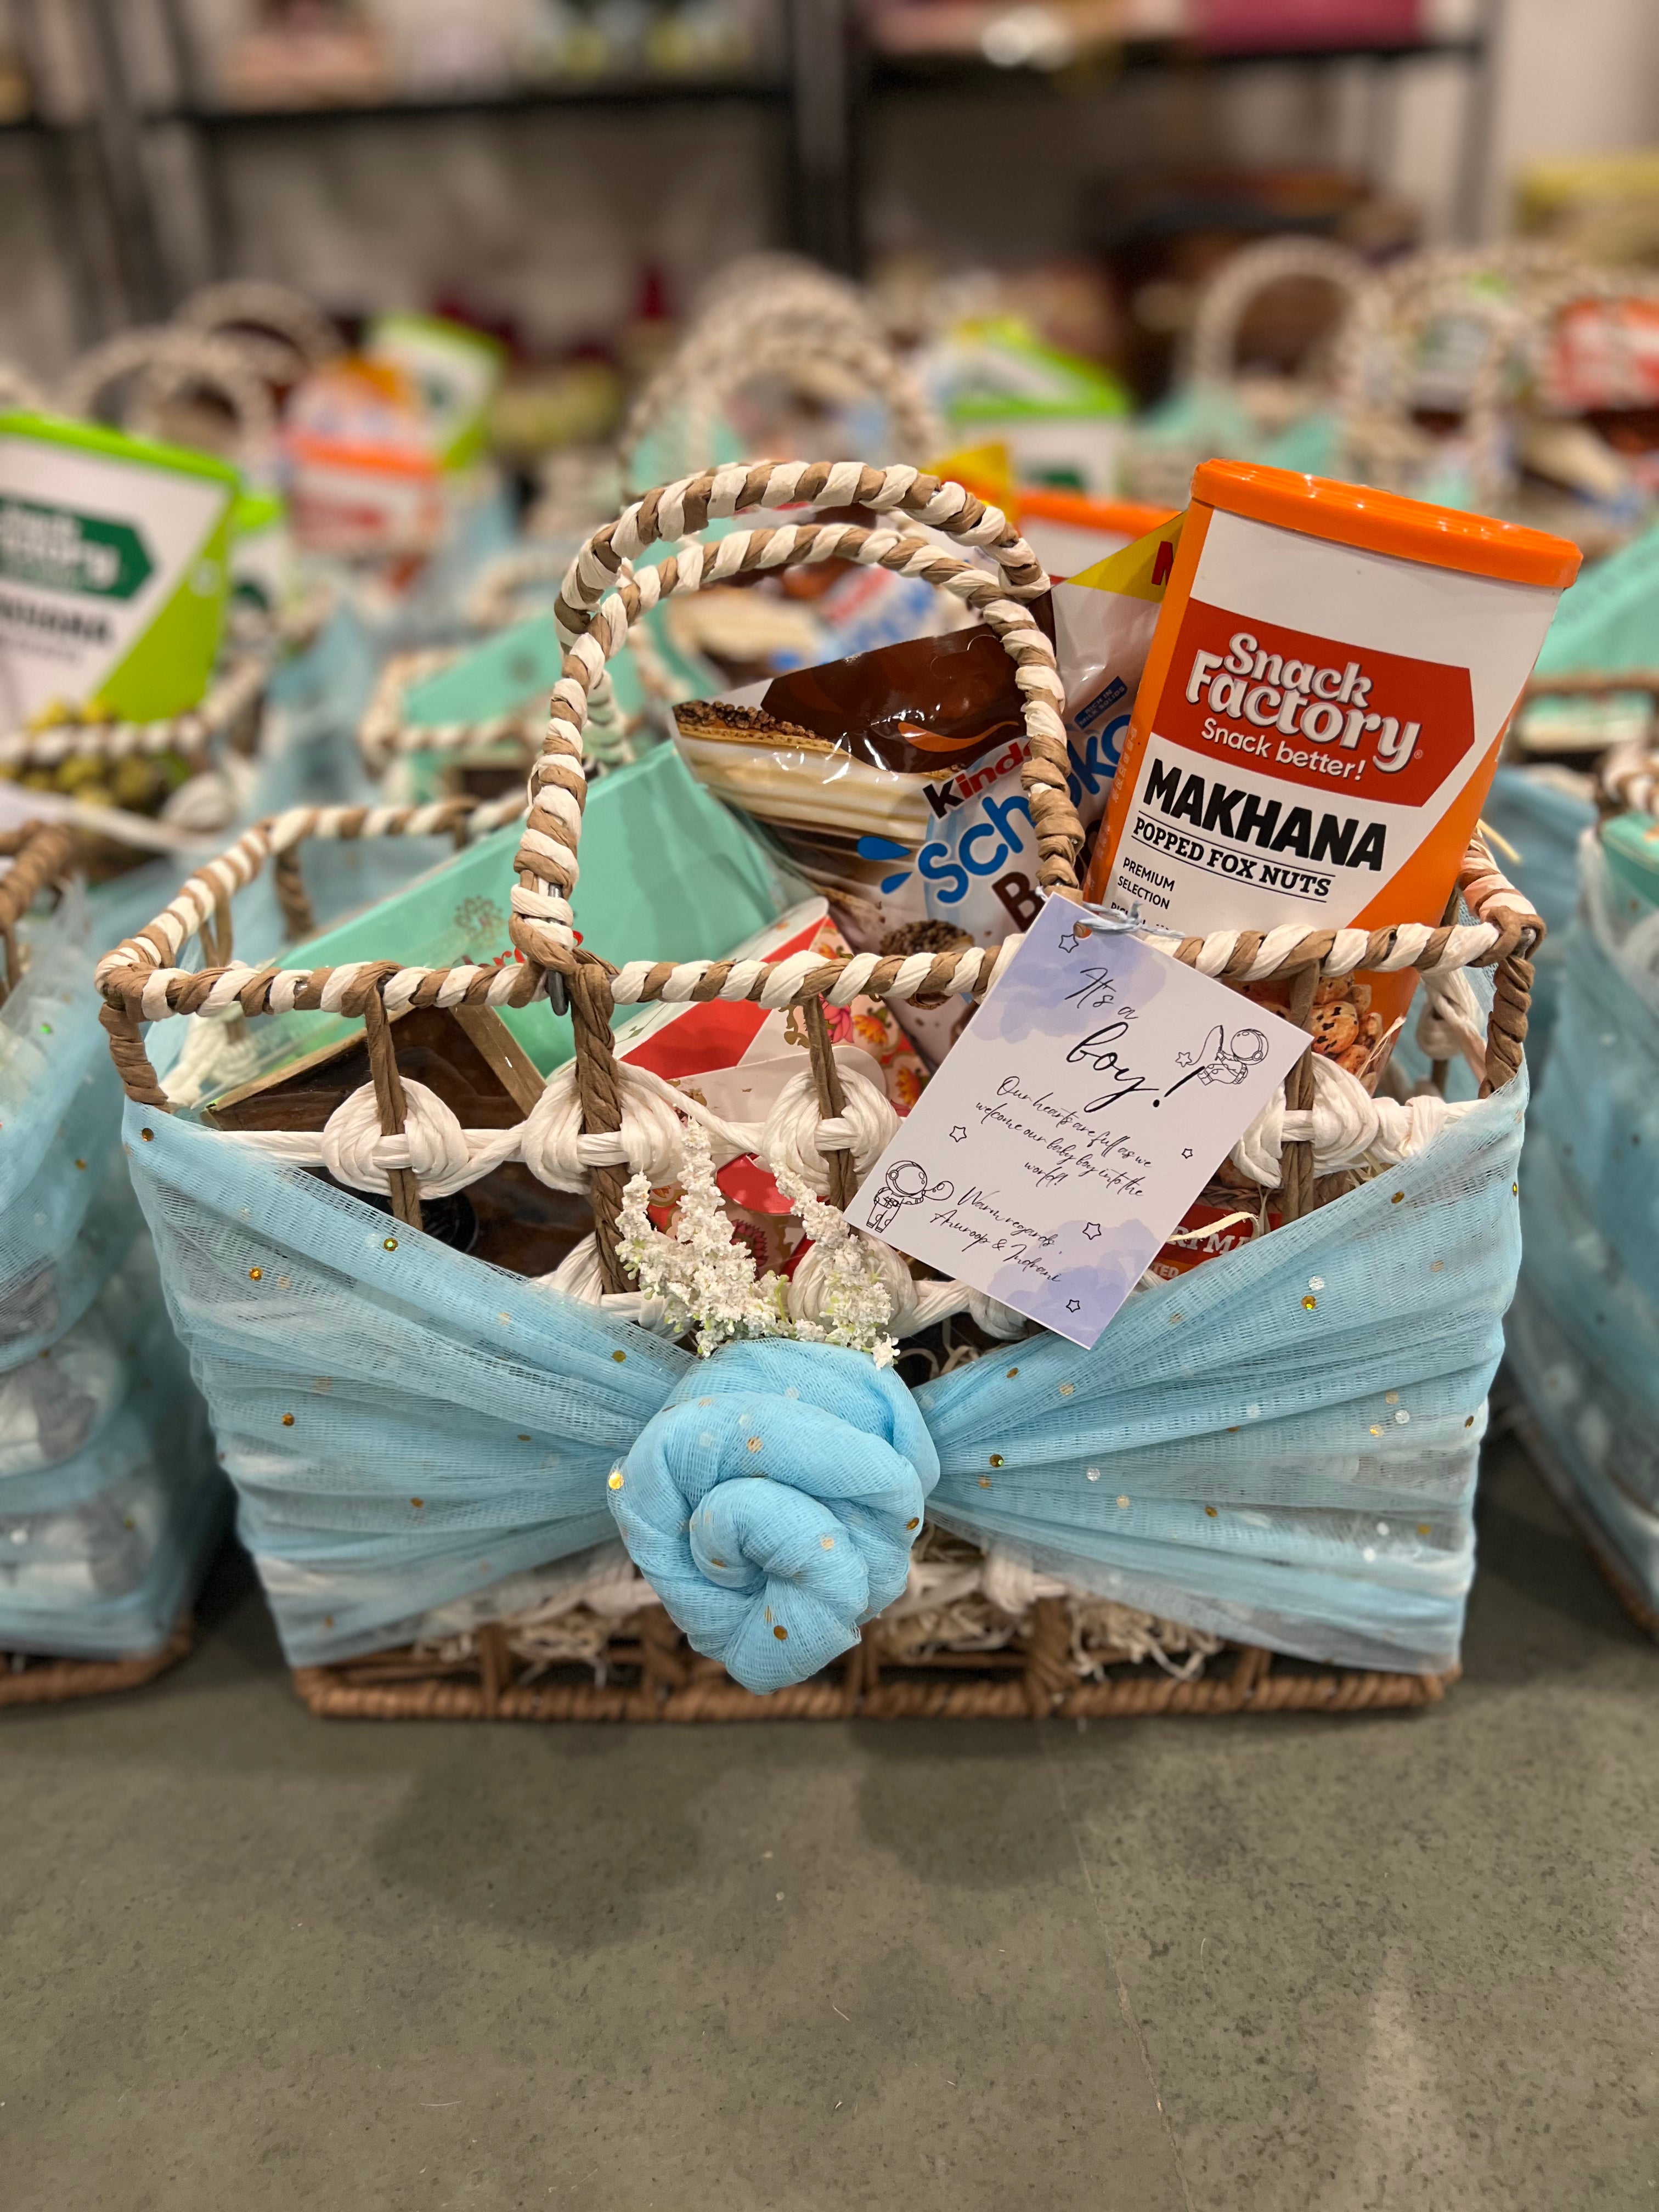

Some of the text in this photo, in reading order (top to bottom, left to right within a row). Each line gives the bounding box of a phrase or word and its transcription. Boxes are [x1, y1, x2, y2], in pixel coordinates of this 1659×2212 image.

[1085, 689, 1113, 714] RICH IN
[1098, 686, 1125, 709] SOLIDS
[1223, 632, 1372, 708] Snack
[1186, 648, 1422, 774] Factory
[1201, 717, 1366, 781] Snack better!
[1143, 758, 1387, 872] MAKHANA
[1123, 857, 1175, 891] PREMIUM
[1133, 817, 1204, 862] POPPED
[1206, 848, 1257, 879] FOX
[1260, 864, 1331, 897] NUTS
[1117, 876, 1170, 910] SELECTION
[1118, 1006, 1139, 1019] a
[1066, 1021, 1205, 1113] boy!
[975, 1103, 1144, 1197] welcome our baby boy into the
[997, 1076, 1153, 1168] Our hearts are full as we
[957, 1187, 1005, 1221] Warm
[1025, 1162, 1068, 1187] world!
[929, 1209, 1062, 1282] Anuroop & Indrani
